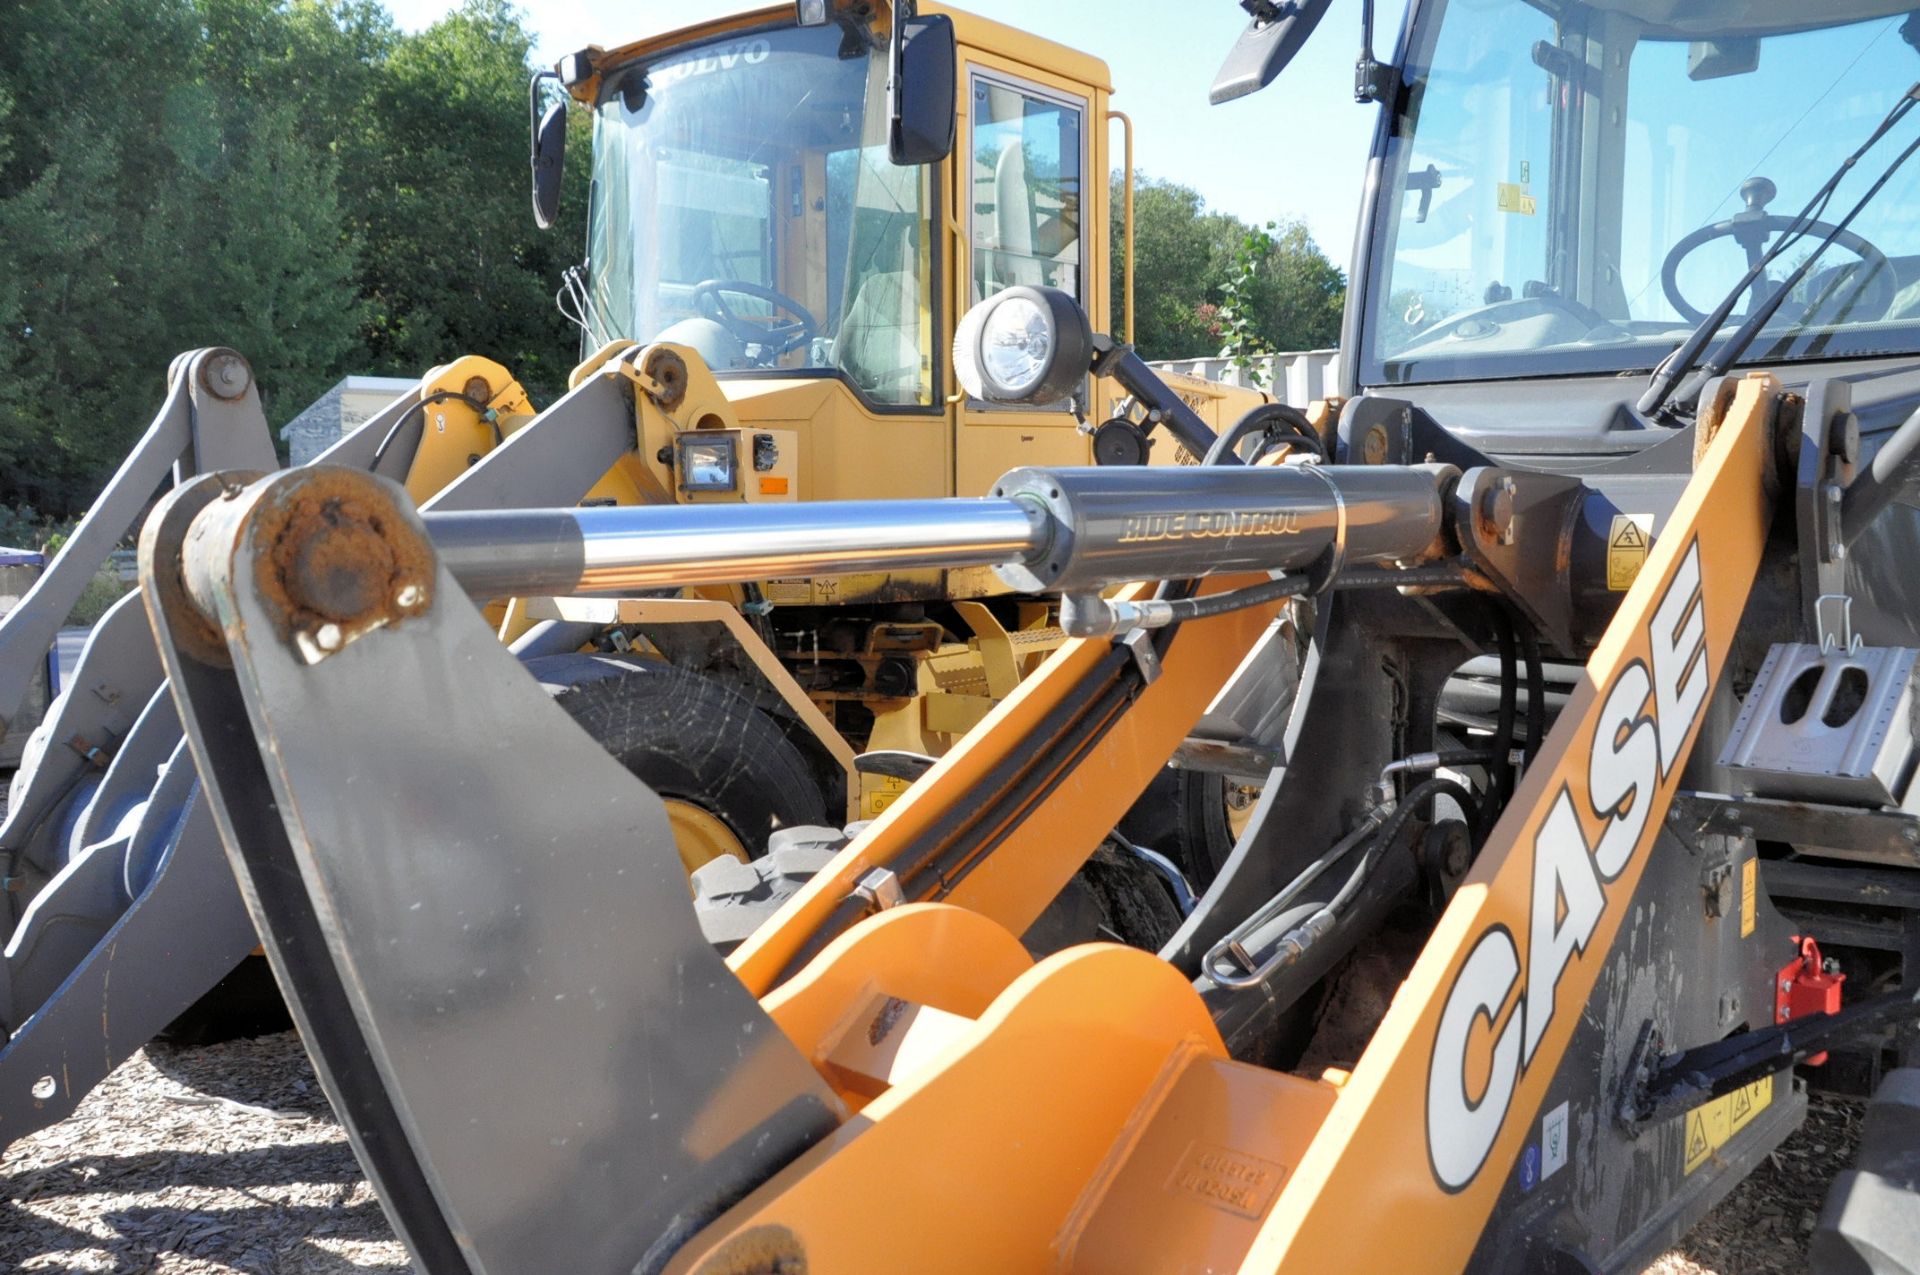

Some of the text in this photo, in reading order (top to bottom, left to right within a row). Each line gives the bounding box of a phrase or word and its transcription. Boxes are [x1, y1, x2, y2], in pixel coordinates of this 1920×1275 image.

[656, 39, 771, 82] OLVO
[1118, 511, 1301, 542] RIDE CONTROL
[1425, 531, 1709, 1194] CASE
